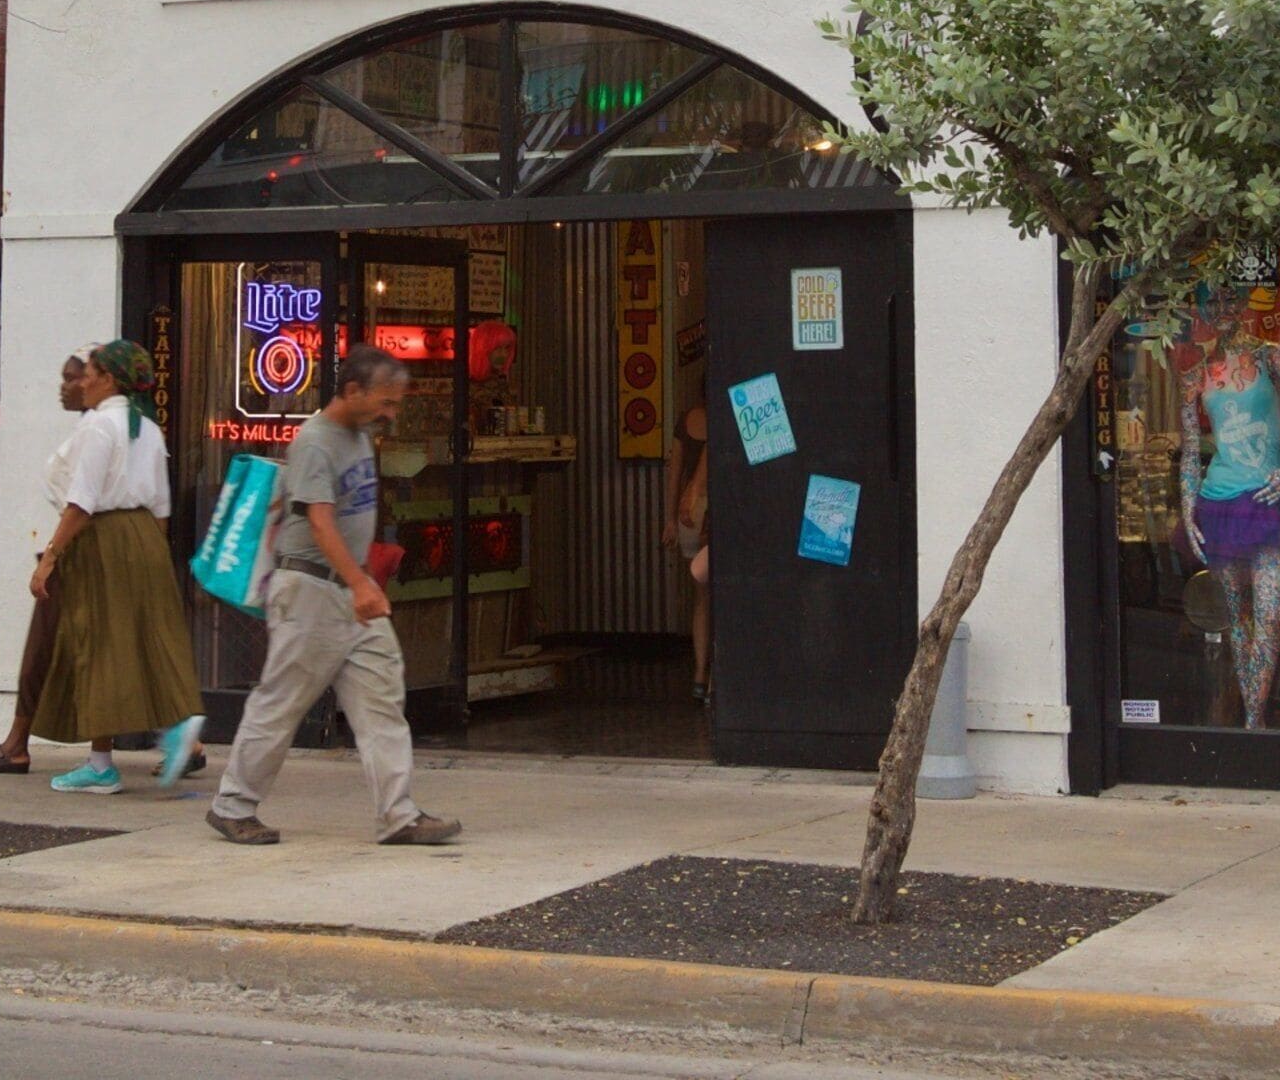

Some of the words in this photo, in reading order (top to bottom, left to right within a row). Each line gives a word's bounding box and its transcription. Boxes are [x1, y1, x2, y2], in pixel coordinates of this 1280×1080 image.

[798, 275, 824, 294] COLD
[243, 282, 322, 333] Lite
[797, 293, 836, 320] BEER
[802, 323, 833, 343] HERE!
[739, 397, 780, 441] Beer
[209, 421, 240, 441] IT'S
